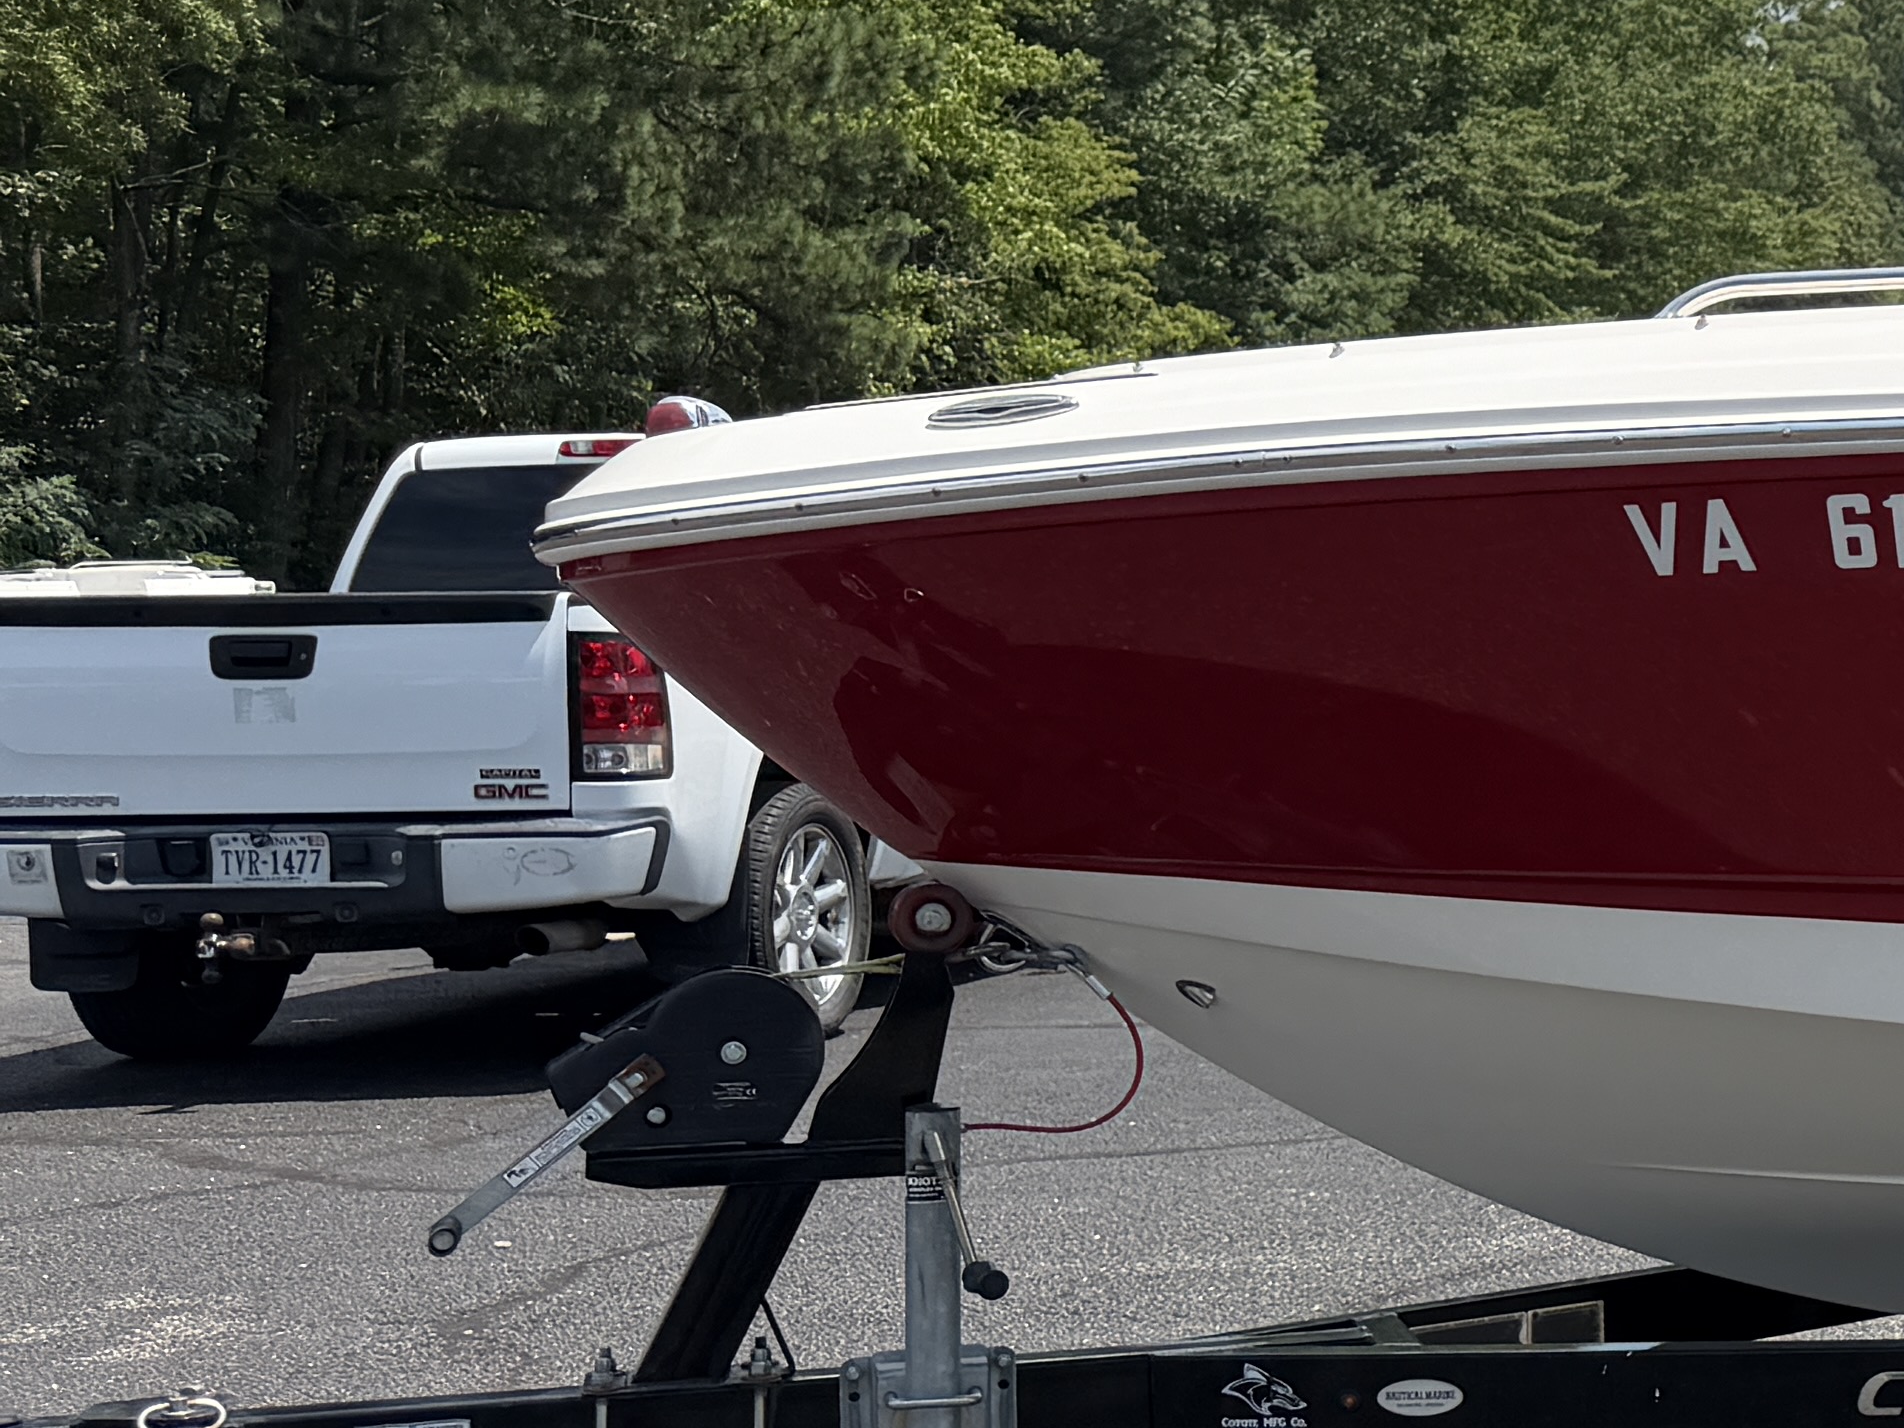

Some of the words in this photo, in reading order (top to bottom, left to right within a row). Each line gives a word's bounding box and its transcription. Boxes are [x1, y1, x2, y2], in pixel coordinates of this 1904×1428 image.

[1623, 498, 1757, 575] VA
[474, 784, 549, 800] GMC
[221, 849, 321, 875] TVR-1477
